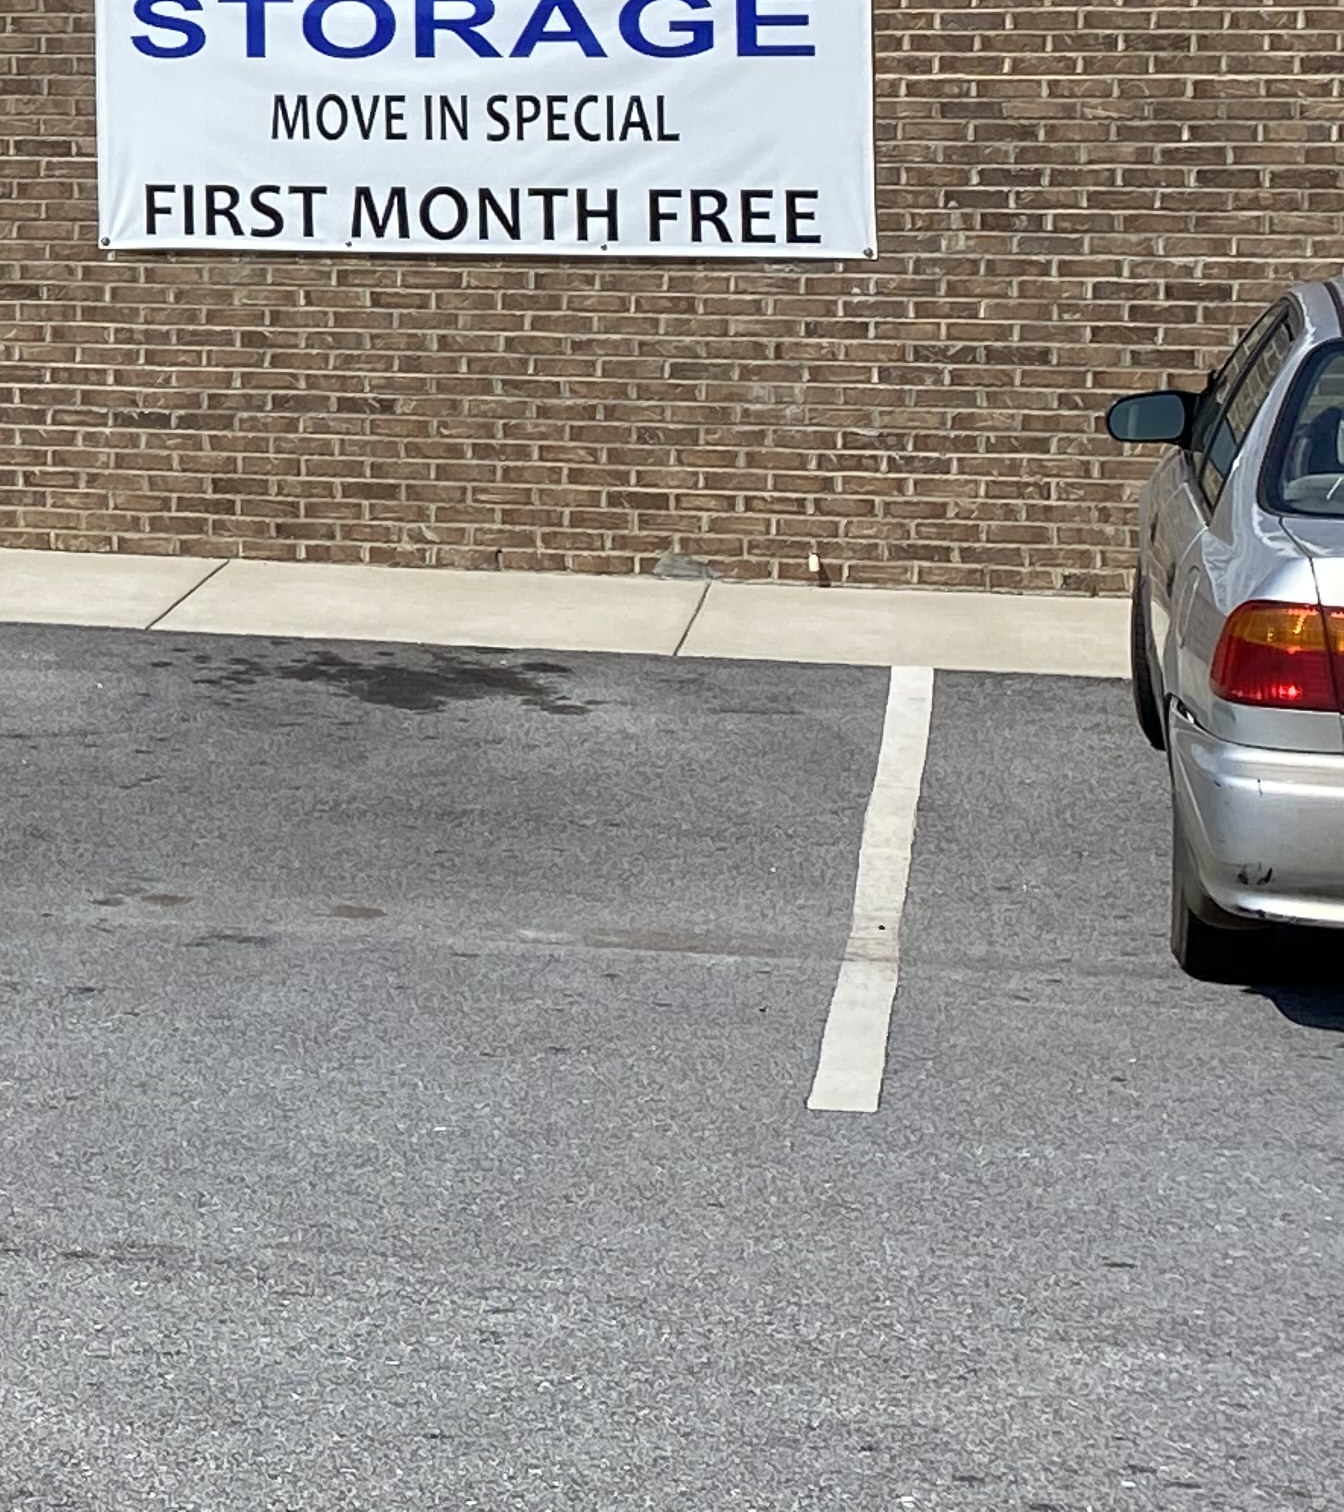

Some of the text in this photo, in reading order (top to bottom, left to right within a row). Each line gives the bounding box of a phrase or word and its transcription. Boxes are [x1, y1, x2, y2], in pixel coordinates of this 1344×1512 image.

[270, 94, 681, 143] MOVE IN SPECIAL
[144, 184, 823, 245] FIRST MONTH FREE
